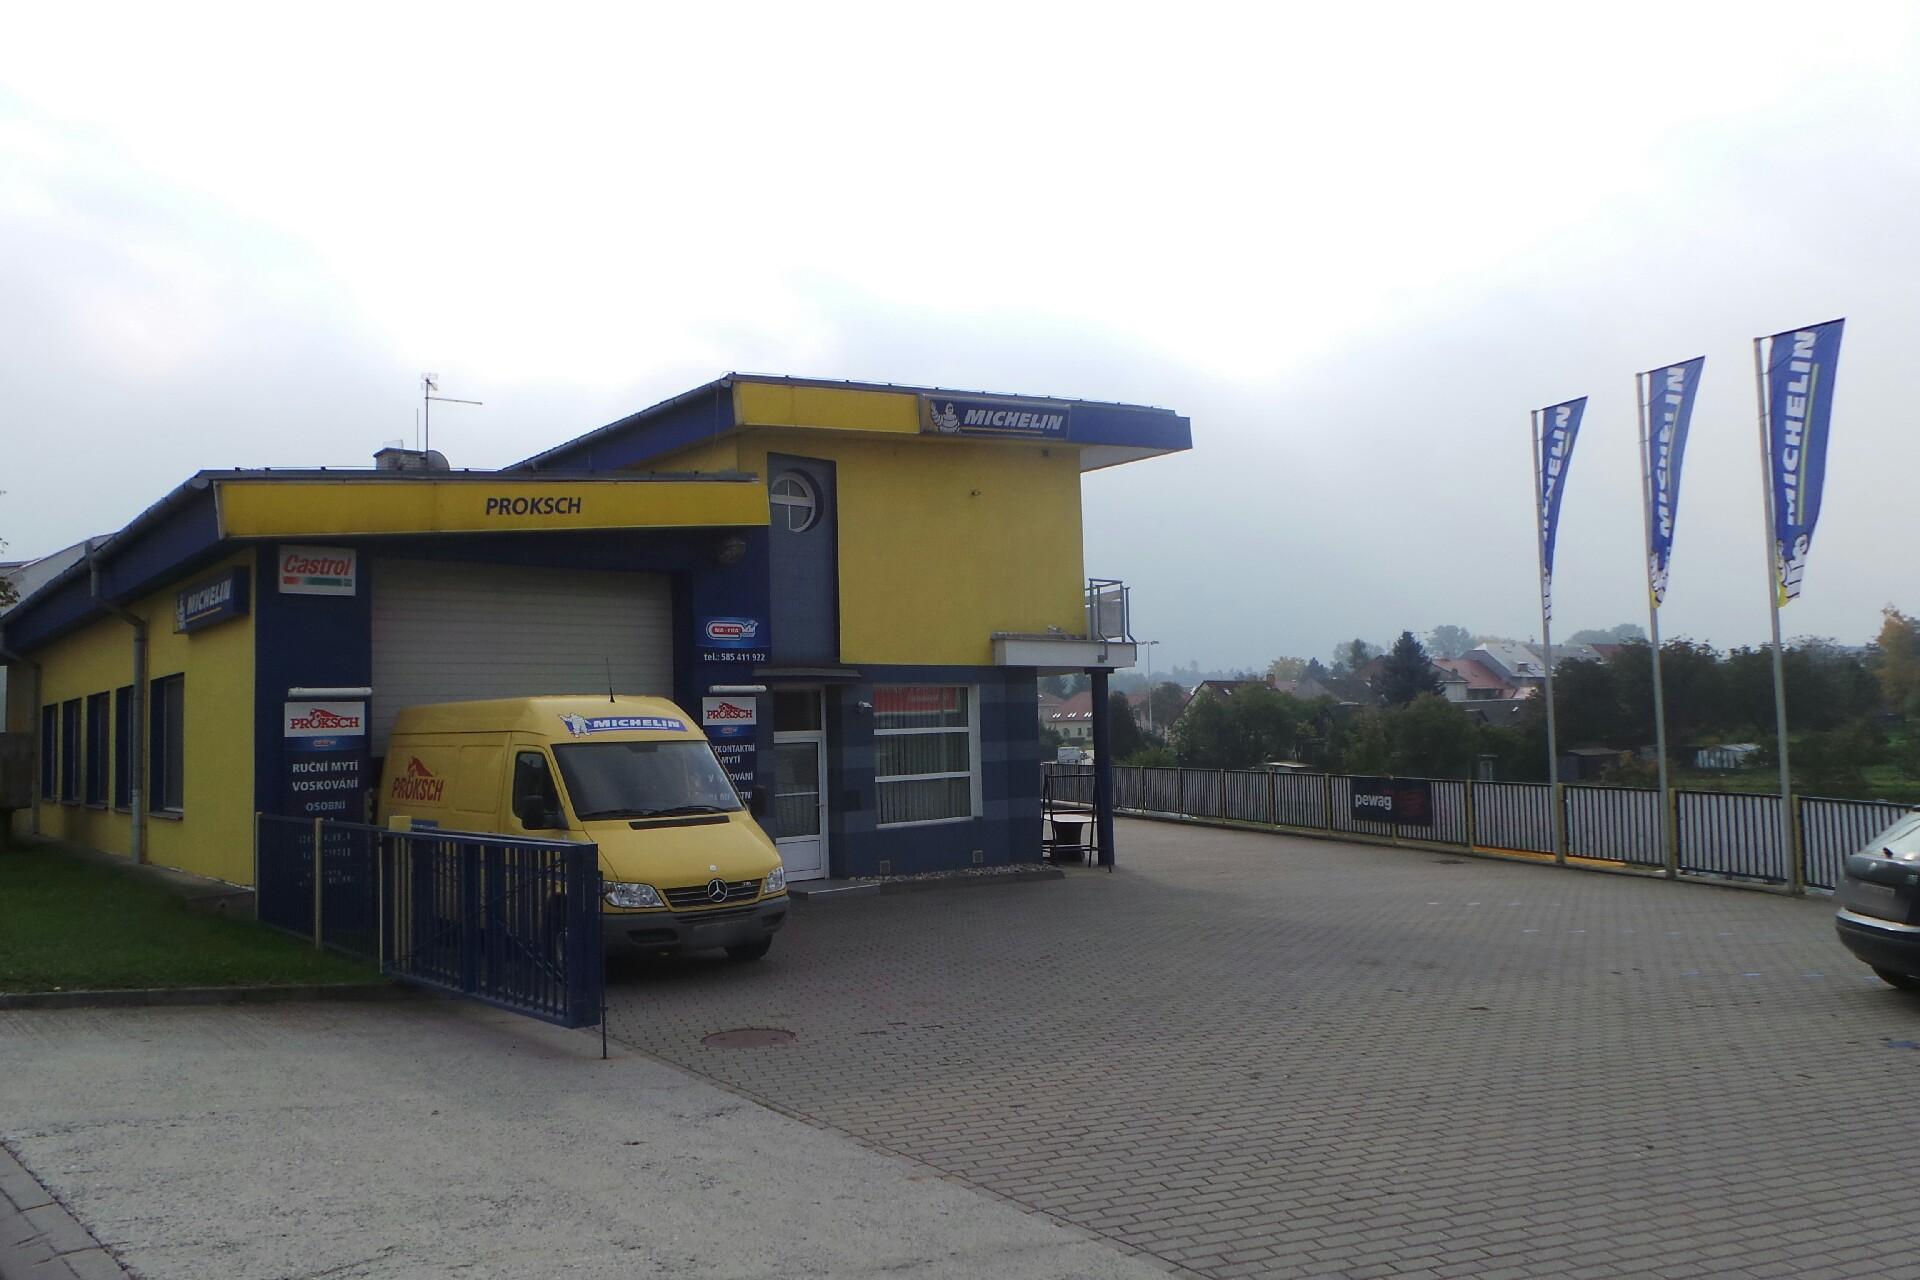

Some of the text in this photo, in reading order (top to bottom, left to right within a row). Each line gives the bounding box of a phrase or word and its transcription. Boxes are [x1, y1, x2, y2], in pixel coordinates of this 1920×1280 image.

[963, 409, 1064, 430] MICHELIN
[1783, 331, 1816, 526] MICHELIN
[486, 497, 582, 515] PROKSCH
[283, 554, 353, 577] Castrol
[187, 578, 232, 615] MICHELIN
[704, 652, 766, 661] tel.: 585 411 922
[290, 716, 361, 729] PROKSCH
[706, 709, 753, 719] PROKSCH
[593, 719, 681, 728] MICHELIN
[292, 760, 359, 773] RUČNÍ MYTÍ
[292, 777, 359, 791] VOSKOVÁNÍ
[392, 776, 445, 802] PROKSCH
[1355, 794, 1392, 811] pewag
